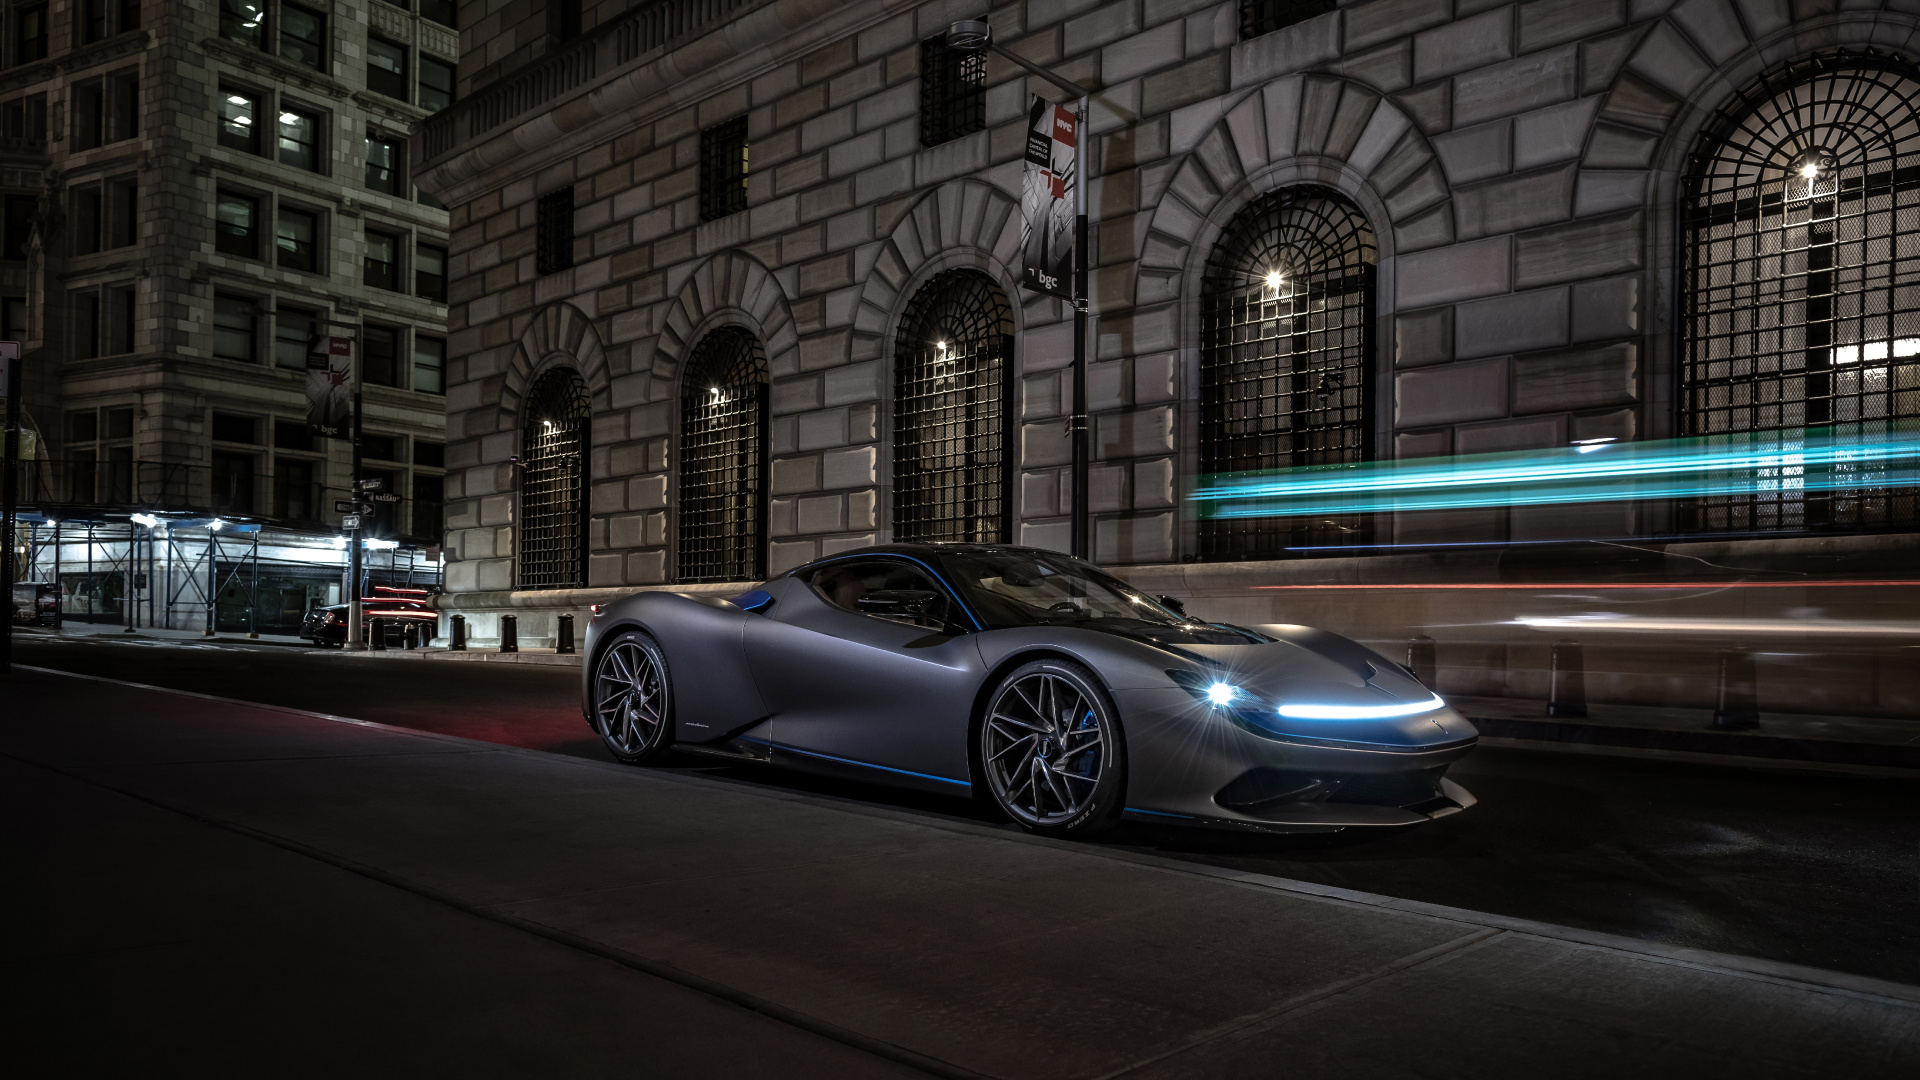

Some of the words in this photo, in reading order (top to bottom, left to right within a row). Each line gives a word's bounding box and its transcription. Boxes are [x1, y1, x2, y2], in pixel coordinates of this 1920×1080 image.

[1056, 118, 1072, 132] NYC
[1039, 269, 1058, 290] bgc
[321, 424, 338, 436] bgc
[375, 494, 397, 502] NASSAU
[1068, 810, 1090, 828] ZERO
